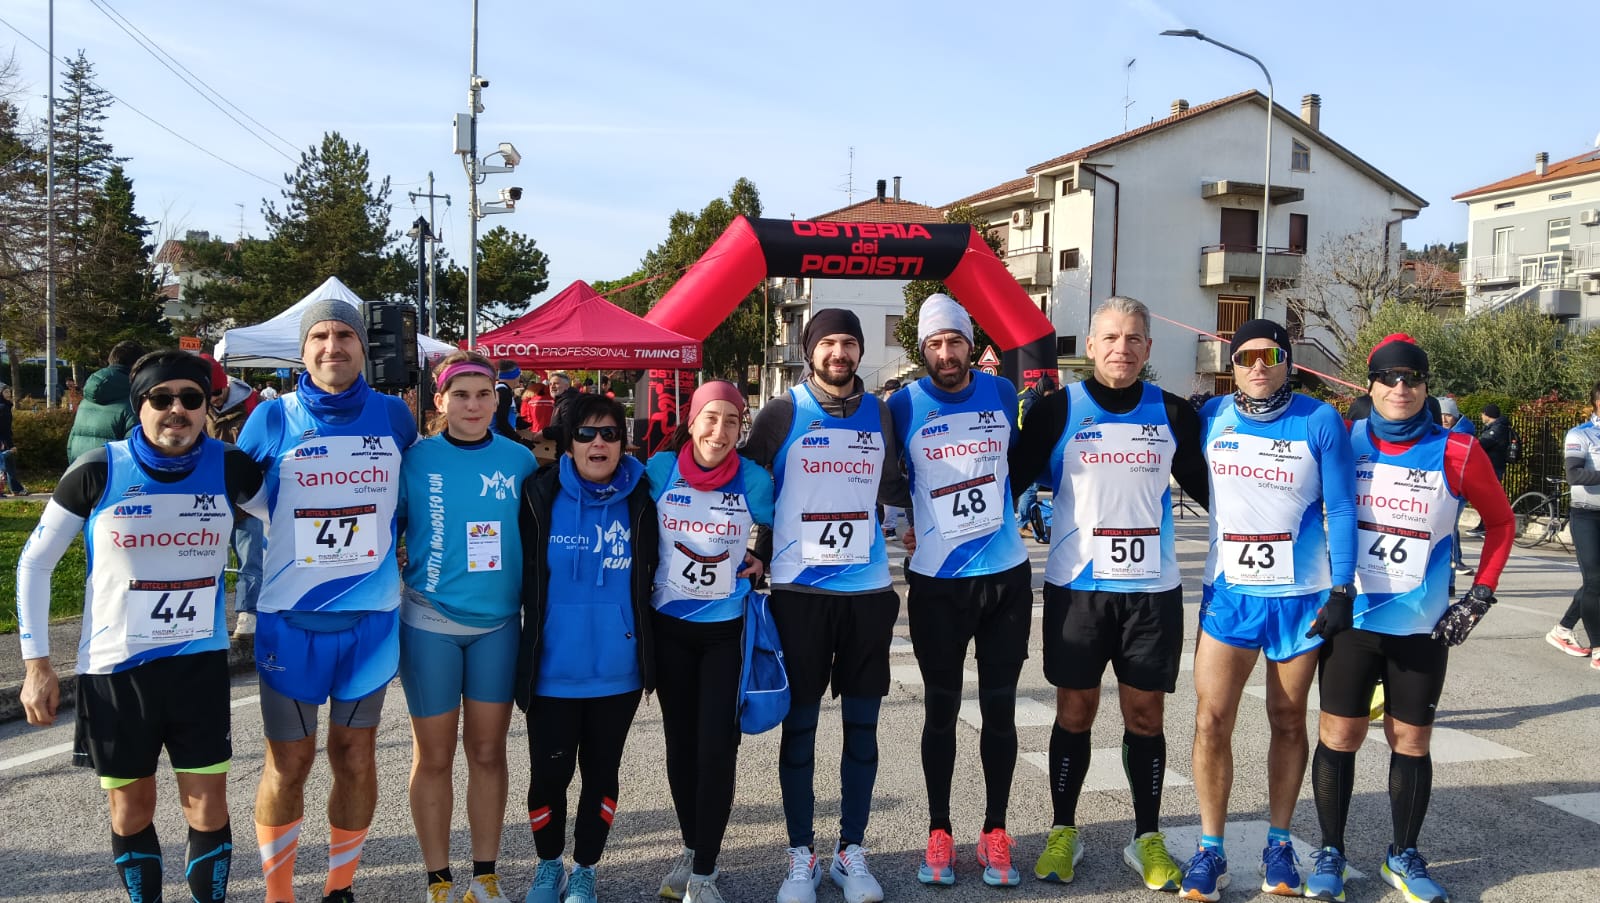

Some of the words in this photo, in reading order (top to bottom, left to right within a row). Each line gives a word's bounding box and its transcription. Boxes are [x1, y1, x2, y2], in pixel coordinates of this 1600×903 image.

[791, 221, 932, 239] OSTERIA
[851, 239, 879, 254] dei
[800, 254, 924, 276] PODISTI
[541, 346, 631, 358] PROFESSIONAL
[634, 348, 680, 359] TIMING
[921, 423, 949, 436] AVIS
[1074, 431, 1103, 440] AVIS
[801, 437, 830, 446] AVIS
[922, 437, 1002, 461] Ranocchi
[1213, 440, 1240, 450] AVIS
[294, 445, 329, 457] AVIS
[1079, 449, 1161, 464] Ranocchi
[801, 458, 875, 475] Ranocchi
[1211, 460, 1294, 483] Ranocchi
[1356, 470, 1374, 479] VIS
[294, 465, 389, 487] Ranocchi
[427, 473, 443, 494] RUN
[353, 485, 387, 494] software
[1257, 481, 1293, 492] software
[665, 493, 692, 505] AVIS
[952, 488, 987, 517] 48
[1356, 494, 1429, 514] anocchi
[113, 504, 153, 516] AVIS
[1391, 513, 1427, 524] software
[429, 496, 445, 550] MONDOLFO
[662, 513, 742, 537] Ranocchi
[111, 528, 220, 548] Ranocchi
[315, 517, 358, 548] 47
[549, 534, 590, 545] nocchi
[819, 522, 854, 549] 49
[178, 547, 217, 557] software
[1111, 537, 1145, 563] 50
[1238, 543, 1275, 569] 43
[1368, 534, 1408, 564] 46
[424, 551, 443, 593] MAROTTA
[603, 557, 632, 569] RUN
[681, 560, 718, 587] 45
[150, 591, 197, 623] 44
